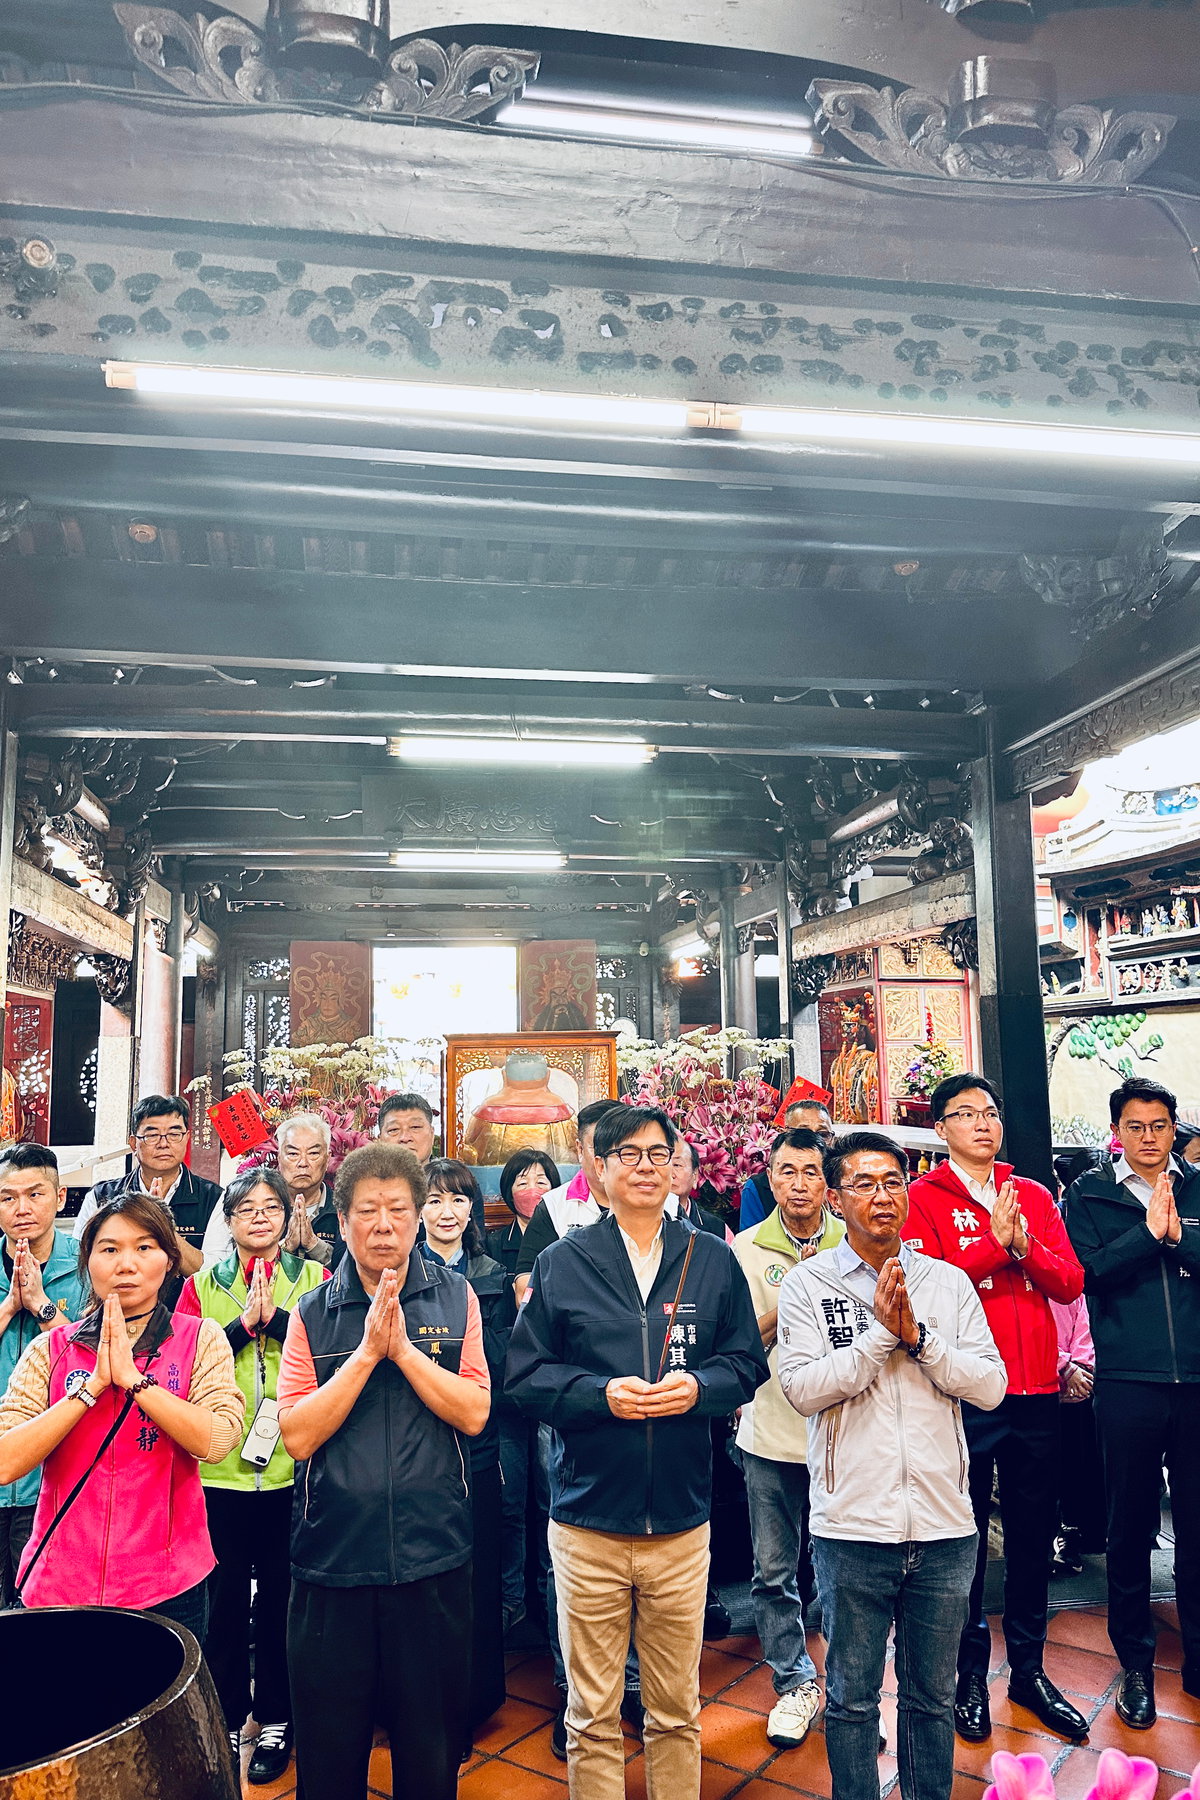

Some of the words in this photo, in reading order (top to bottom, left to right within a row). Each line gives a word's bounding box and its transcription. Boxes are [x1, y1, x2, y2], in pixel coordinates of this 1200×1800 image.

[666, 1323, 687, 1374] 陳其
[686, 1323, 697, 1345] 市長
[168, 1363, 181, 1397] 高雄
